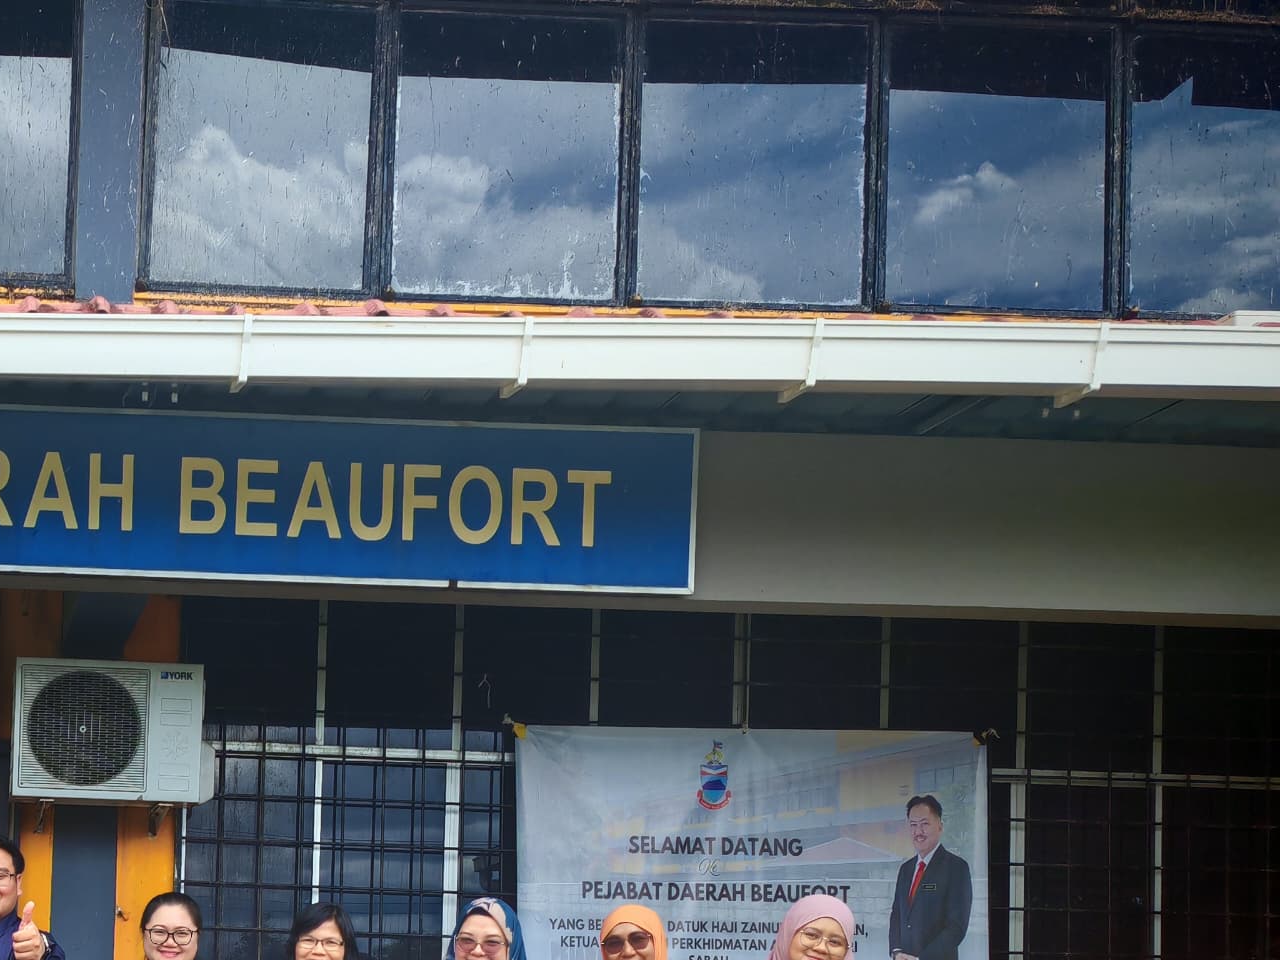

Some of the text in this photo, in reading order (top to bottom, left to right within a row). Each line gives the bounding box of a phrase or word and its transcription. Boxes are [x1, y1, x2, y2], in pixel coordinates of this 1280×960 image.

[178, 456, 612, 548] BEAUFORT
[168, 671, 193, 681] YORK
[628, 834, 803, 857] SELAMAT DATANG
[581, 880, 663, 900] PEJABAT
[667, 881, 745, 902] DAERAH
[549, 918, 585, 930] YANG
[667, 920, 708, 933] DATUK
[711, 921, 738, 933] HAJI
[560, 935, 599, 948] KETUA
[672, 937, 767, 951] PERKHIDMATAN
